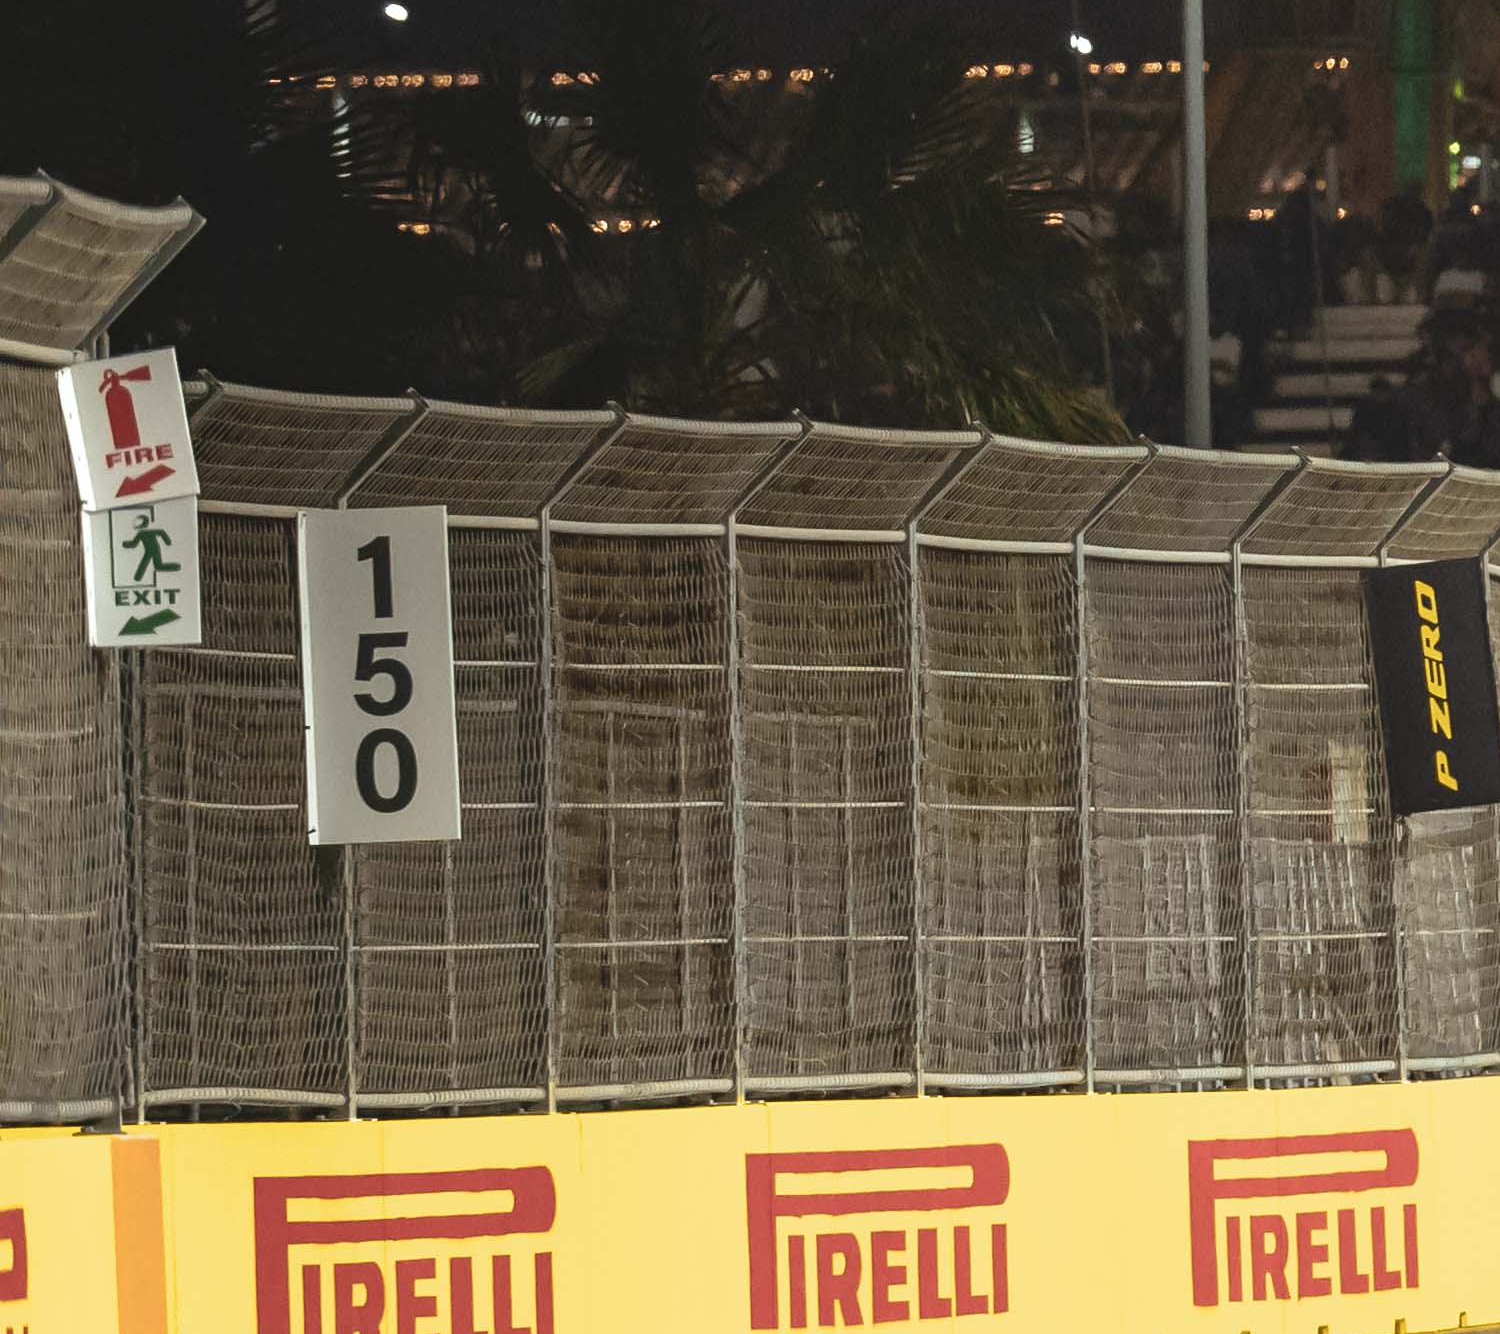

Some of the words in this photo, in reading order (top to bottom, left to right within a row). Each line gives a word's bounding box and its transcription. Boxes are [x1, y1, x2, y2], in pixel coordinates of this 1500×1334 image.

[105, 443, 173, 469] FIRE
[114, 588, 181, 607] EXIT
[354, 535, 418, 814] 150
[1414, 580, 1454, 741] ZERO
[1435, 750, 1459, 791] P
[746, 1143, 1010, 1331] PIRELLI
[1188, 1128, 1420, 1308] PIRELLI
